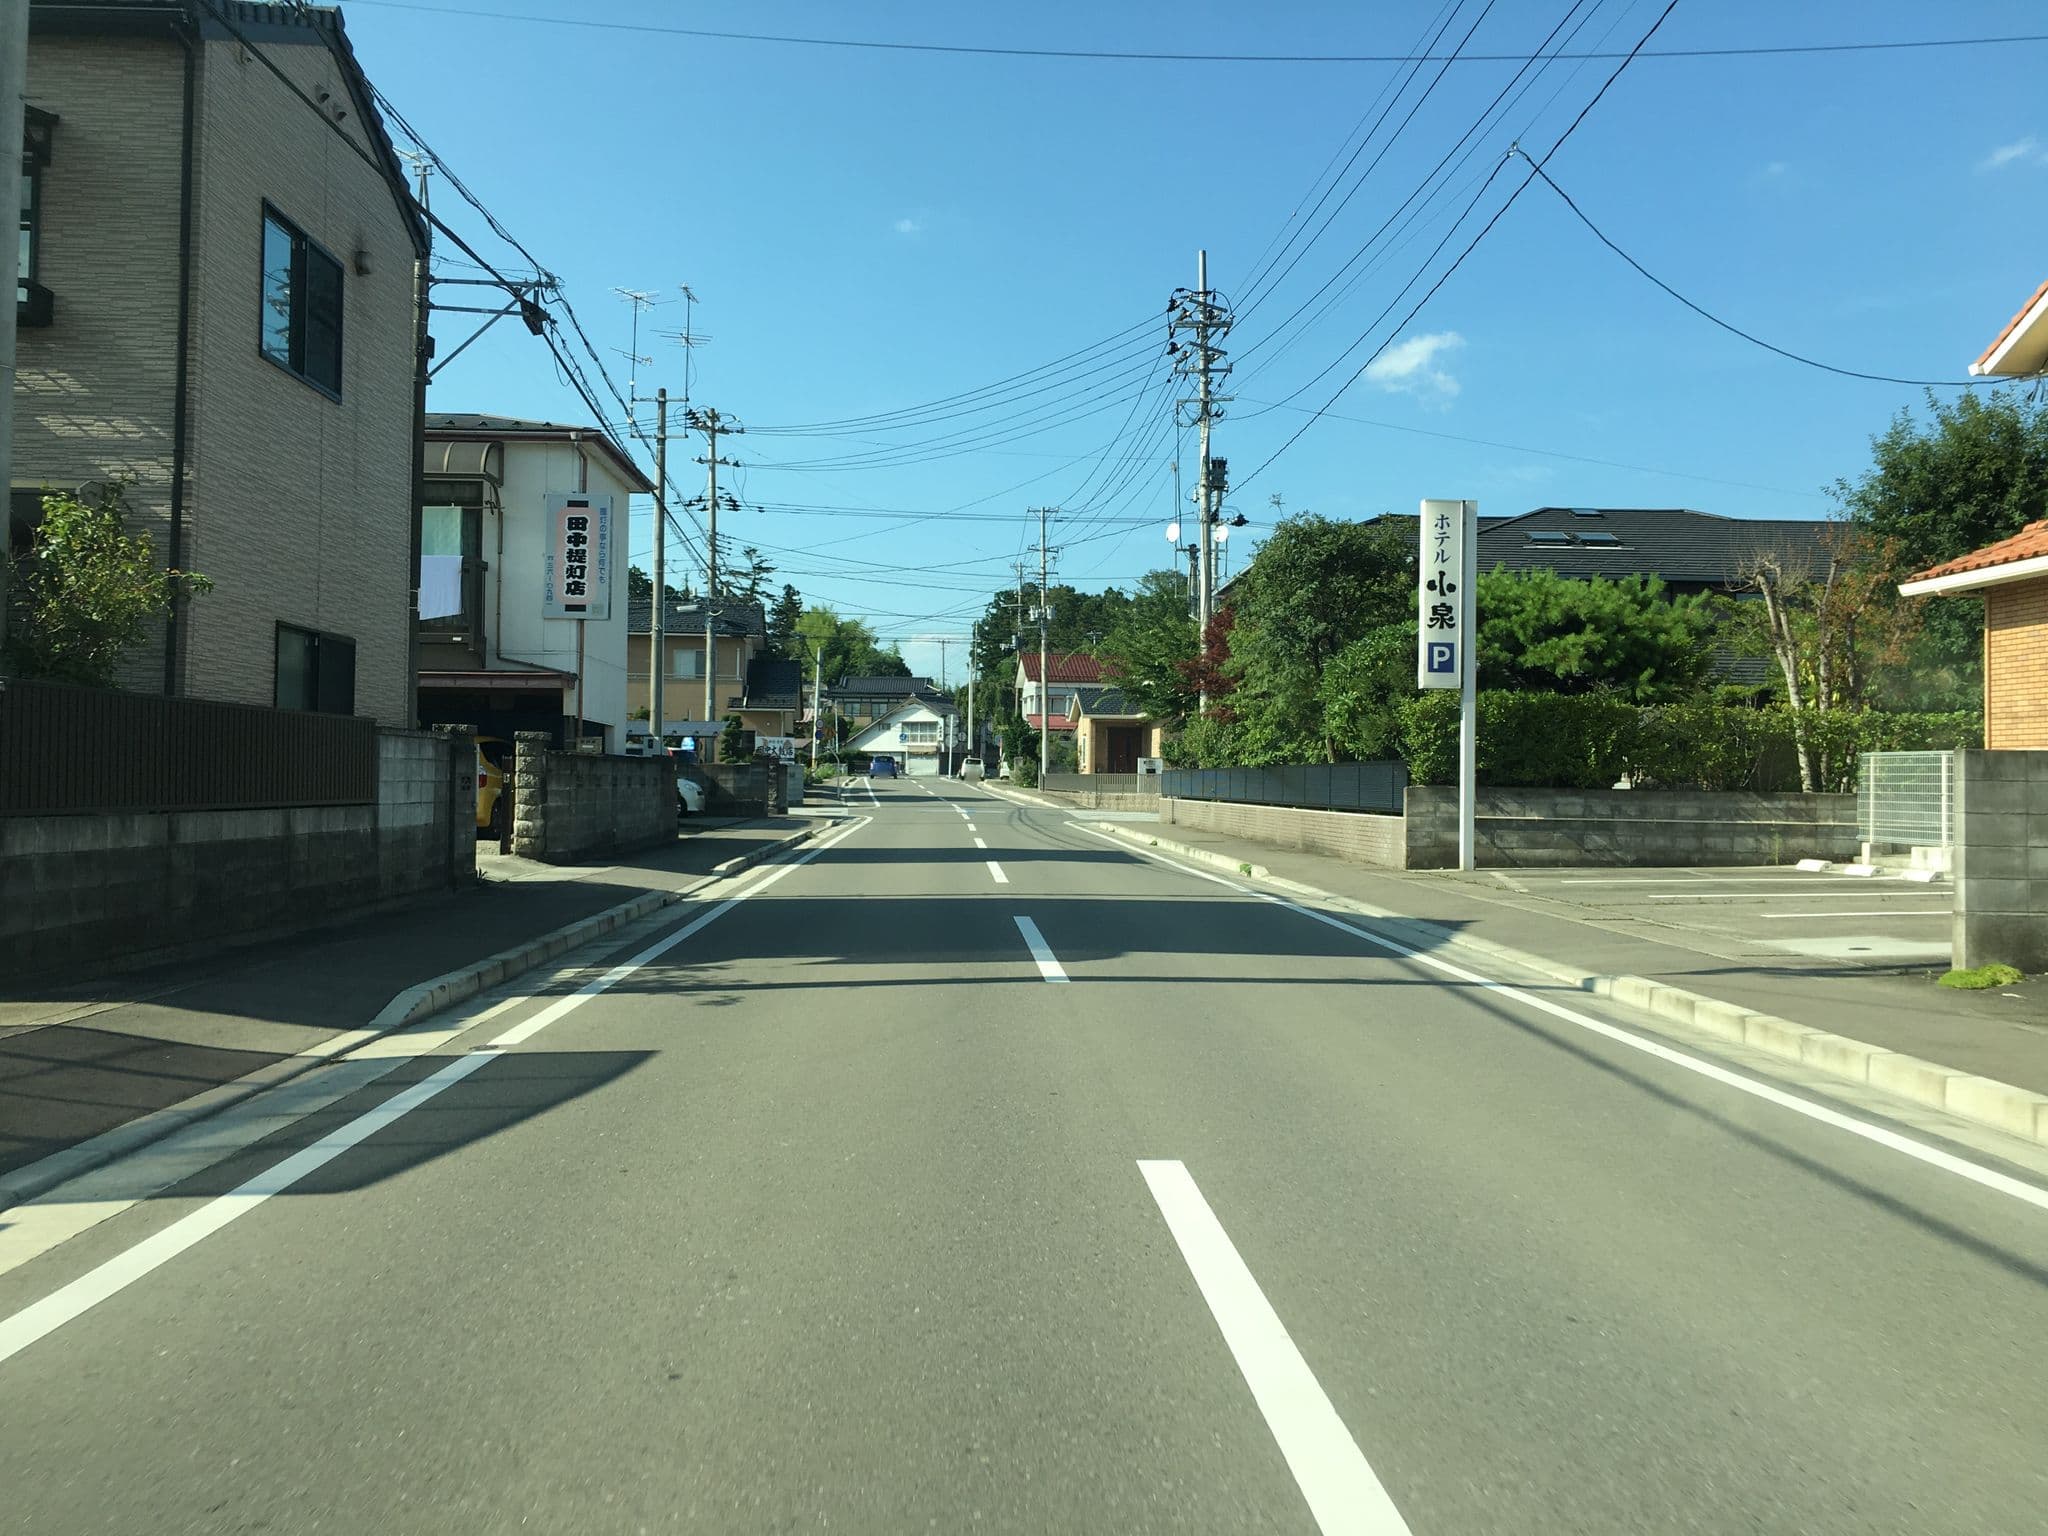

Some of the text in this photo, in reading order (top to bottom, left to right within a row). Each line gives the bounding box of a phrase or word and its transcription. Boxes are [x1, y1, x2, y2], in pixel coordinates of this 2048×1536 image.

[565, 516, 589, 596] 田中提灯店
[1426, 513, 1457, 630] ホテル小泉
[1432, 645, 1451, 670] P
